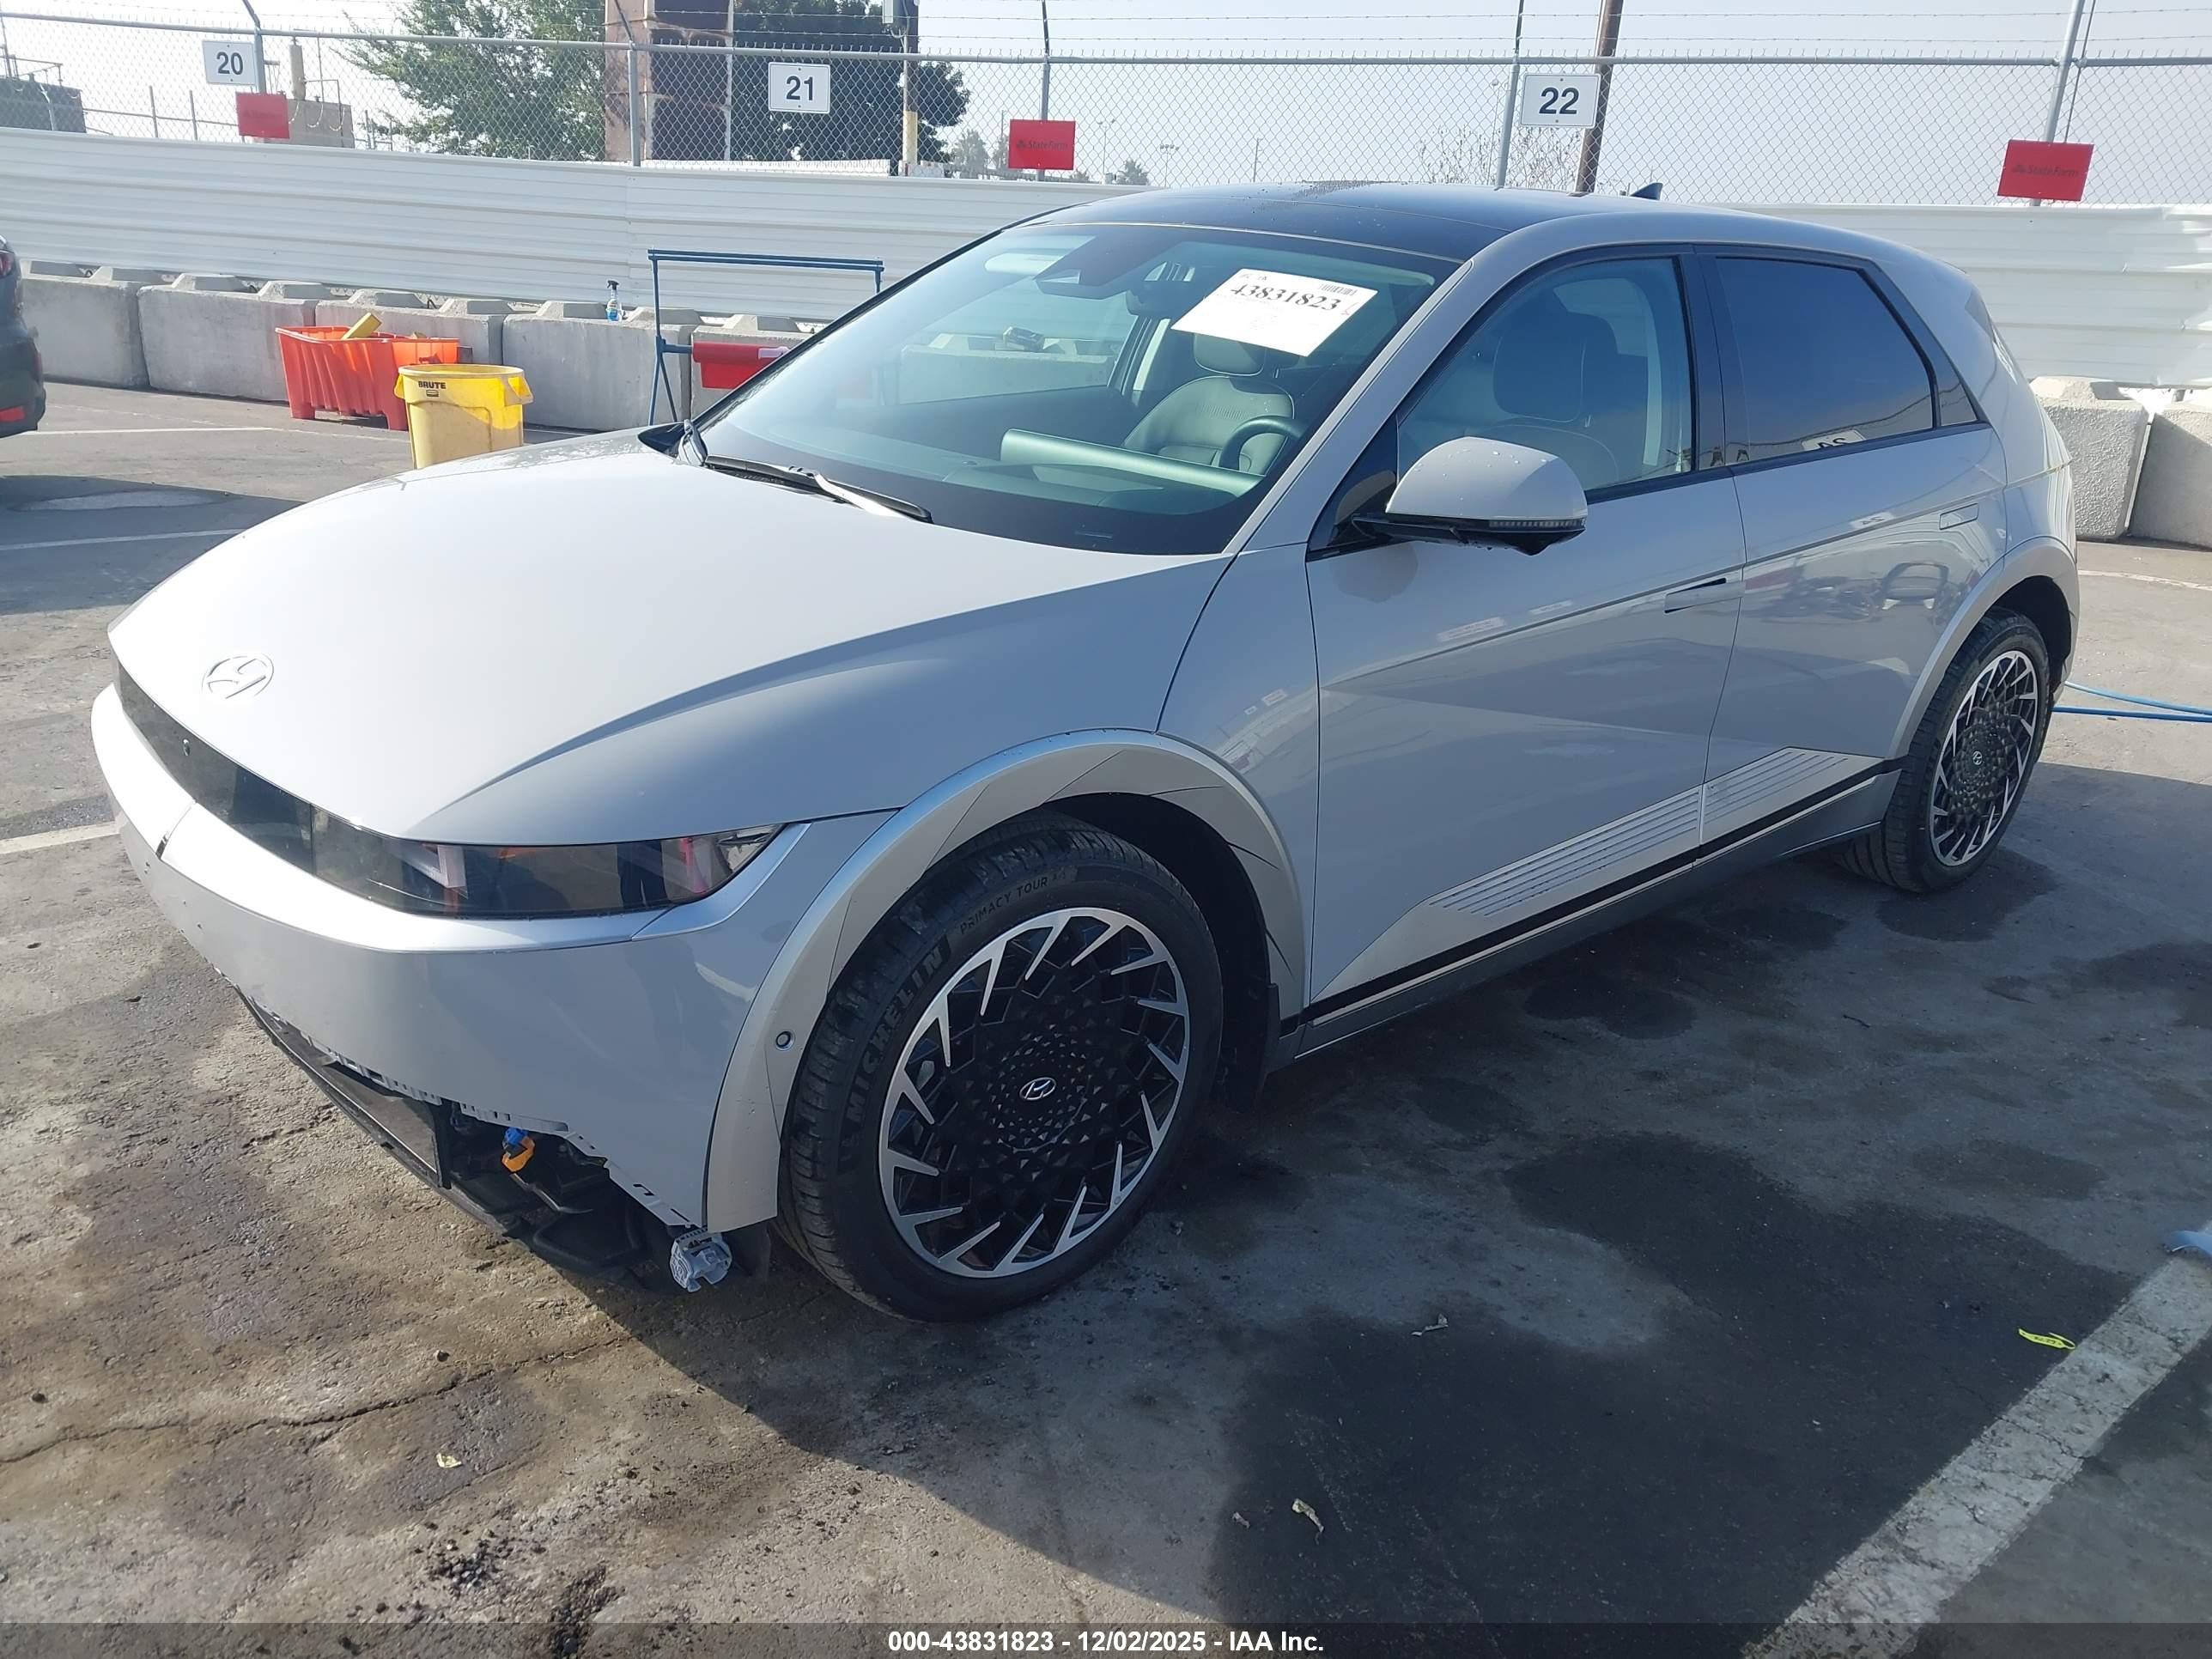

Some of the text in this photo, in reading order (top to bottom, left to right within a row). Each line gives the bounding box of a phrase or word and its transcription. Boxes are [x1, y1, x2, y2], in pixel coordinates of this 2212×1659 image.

[216, 52, 244, 76] 20
[786, 76, 813, 101] 21
[1538, 87, 1579, 114] 22
[1230, 283, 1341, 311] 43831823
[418, 380, 447, 389] BRUTE
[959, 876, 1048, 935] PRIMACY TOUR
[845, 944, 944, 1123] MICHELIN
